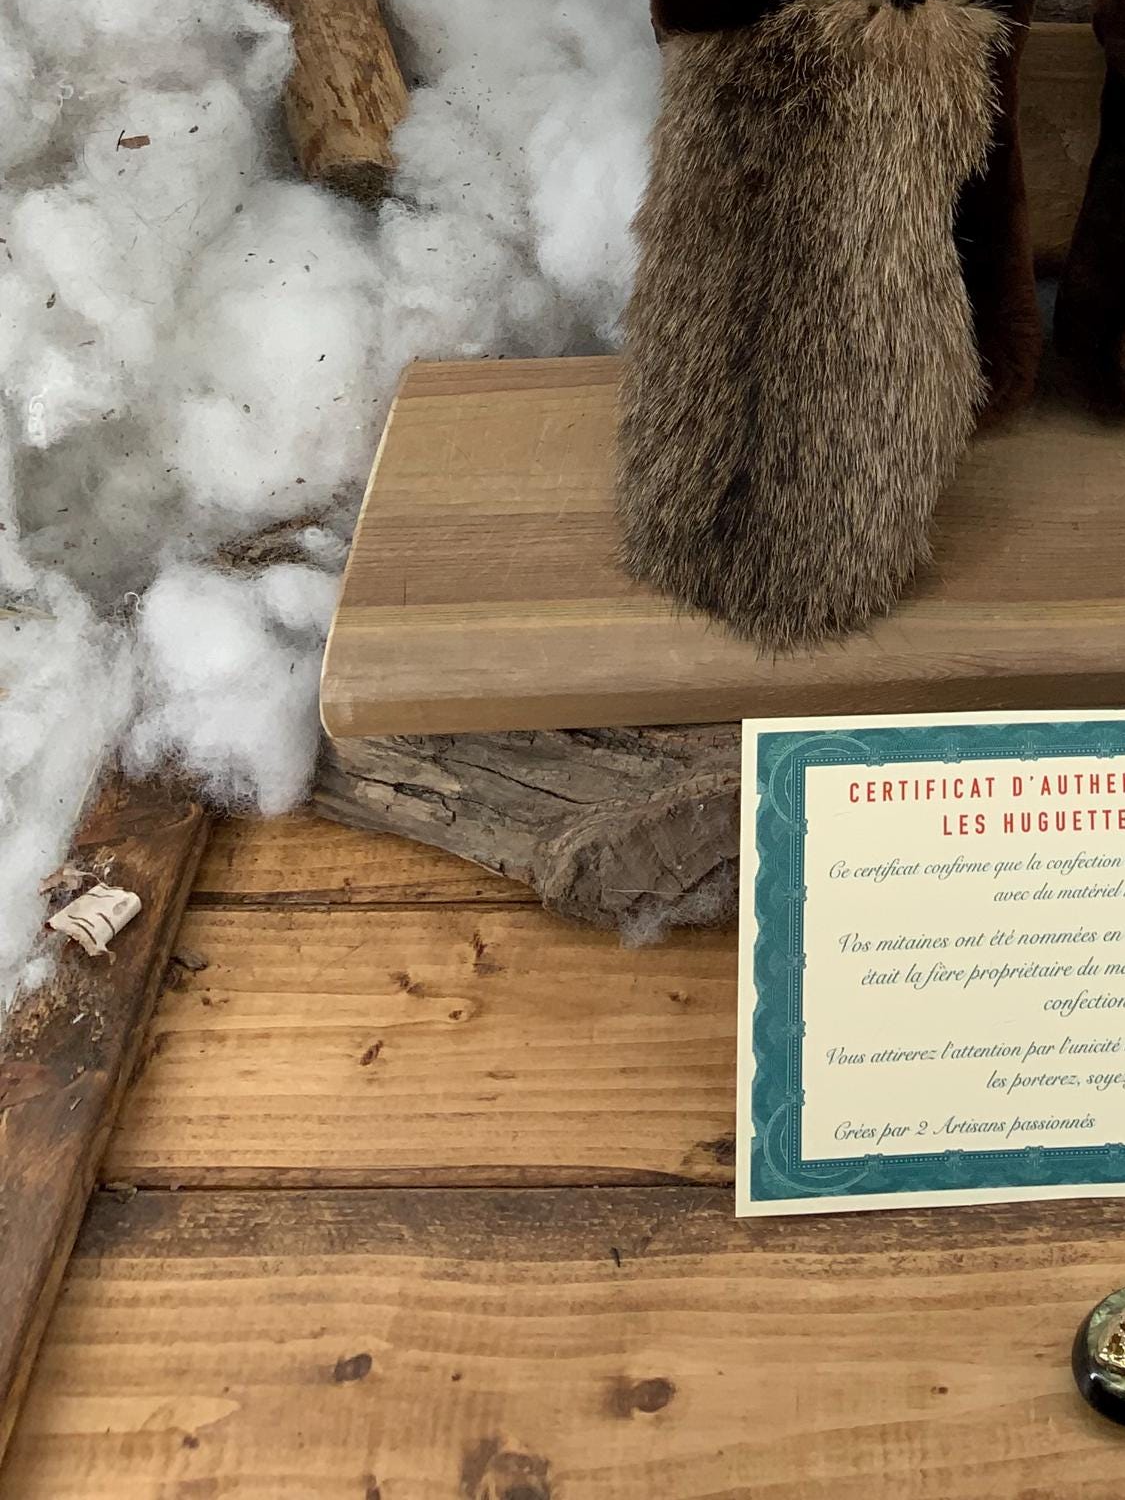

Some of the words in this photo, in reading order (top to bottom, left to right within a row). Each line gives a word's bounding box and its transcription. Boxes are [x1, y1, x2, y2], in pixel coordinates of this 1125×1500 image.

[849, 777, 996, 803] CERTIFICAT
[943, 815, 986, 836] LES
[853, 858, 921, 883] certificat
[924, 855, 991, 880] confirme
[994, 860, 1023, 879] que
[1026, 852, 1042, 871] la
[1046, 851, 1122, 875] confection
[993, 890, 1029, 902] avec
[1033, 882, 1053, 900] du
[1057, 879, 1124, 899] matériel
[838, 933, 871, 954] Vos
[876, 933, 949, 952] mitaines
[955, 932, 984, 948] ont
[990, 929, 1016, 946] été
[1017, 926, 1099, 945] nommées
[1103, 929, 1122, 942] en
[861, 968, 901, 986] était
[905, 963, 922, 984] la
[914, 960, 966, 990] fière
[963, 960, 1073, 989] propriétaire
[1077, 955, 1099, 976] du
[827, 1046, 865, 1066] Vous
[870, 1047, 937, 1063] attirerez
[940, 1040, 1022, 1060] l'attention
[1021, 1040, 1056, 1064] par
[1058, 1036, 1121, 1055] l'unicité
[986, 1069, 1008, 1089] les
[1007, 1073, 1081, 1096] porterez,
[833, 1121, 877, 1141] Crées
[876, 1123, 911, 1146] par
[915, 1120, 930, 1136] 2
[932, 1115, 1007, 1137] Artisans
[1005, 1112, 1096, 1139] passionnés
